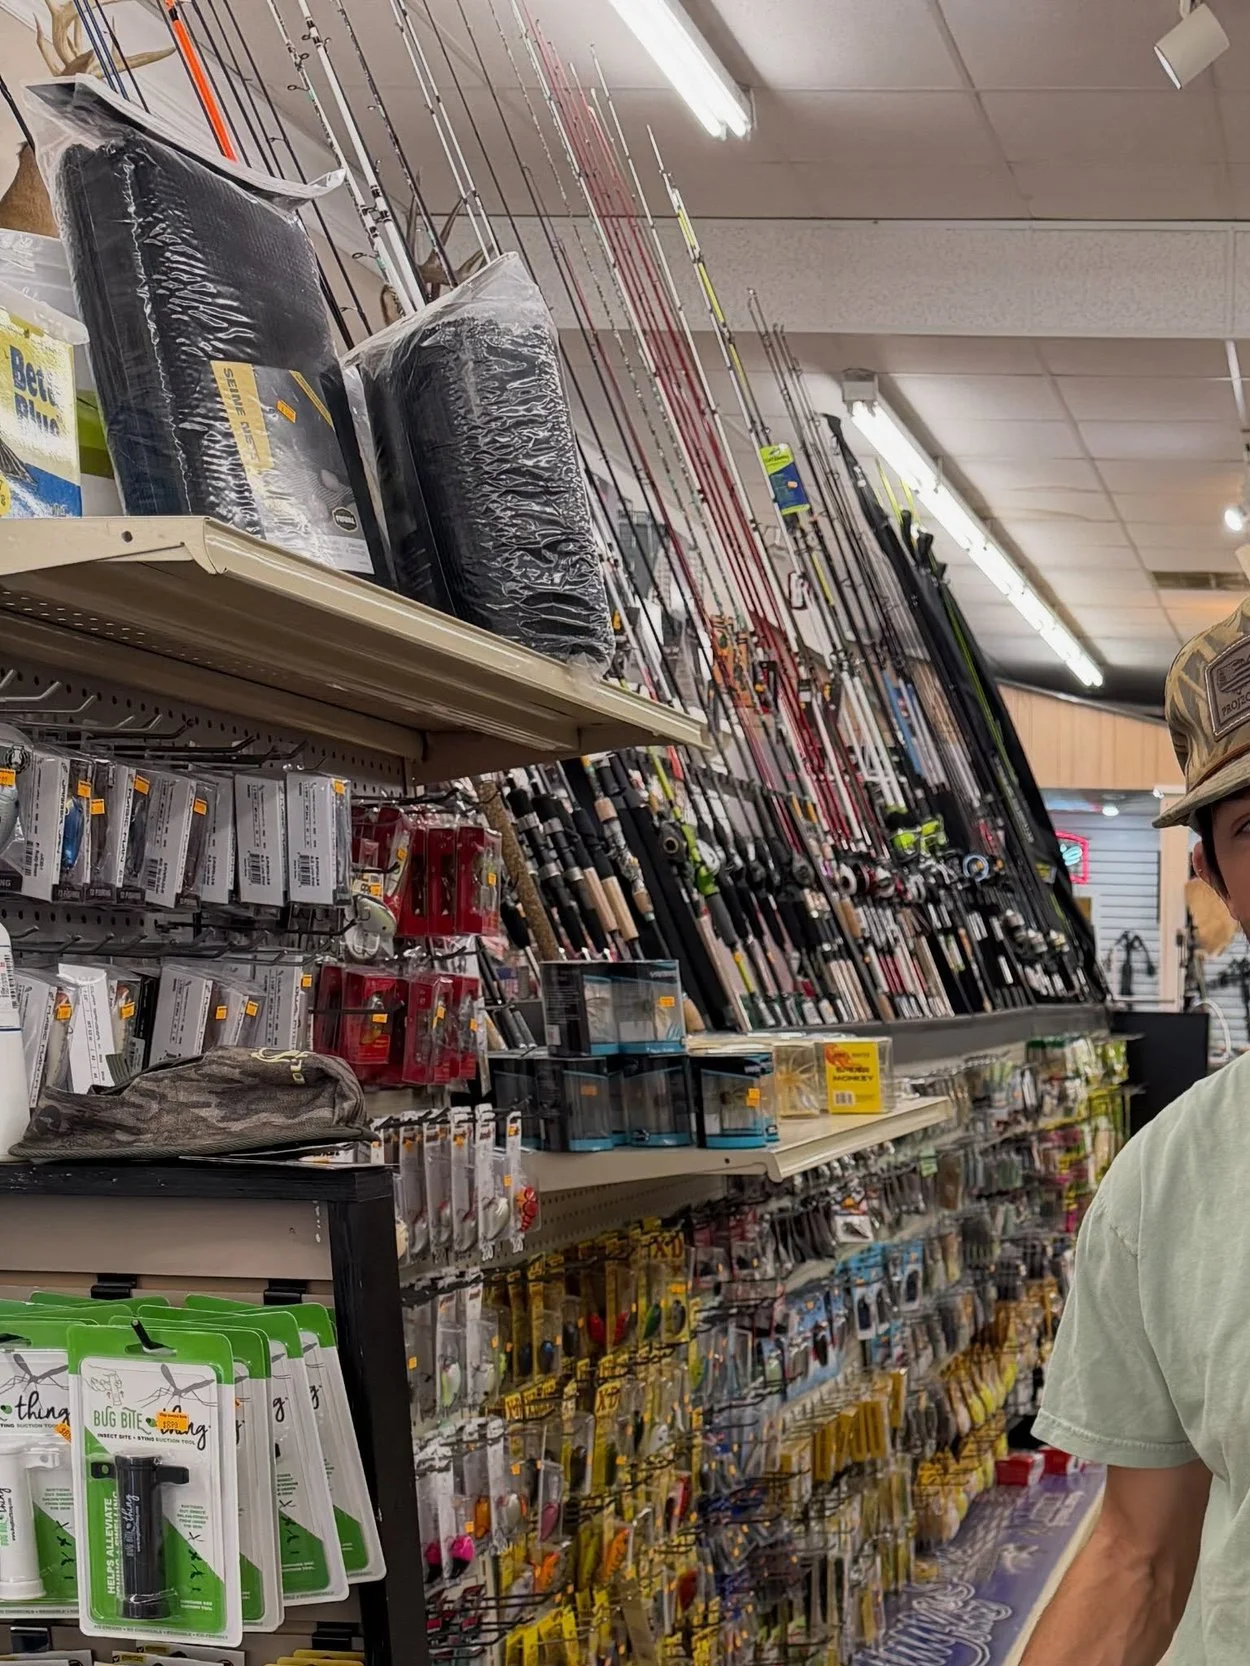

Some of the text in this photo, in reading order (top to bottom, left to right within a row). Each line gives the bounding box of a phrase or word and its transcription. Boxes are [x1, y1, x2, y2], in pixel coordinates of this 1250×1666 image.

[223, 368, 245, 416] SEINE
[93, 1406, 143, 1430] BUG BITE
[104, 1498, 117, 1595] HELPS ALLEVIATE
